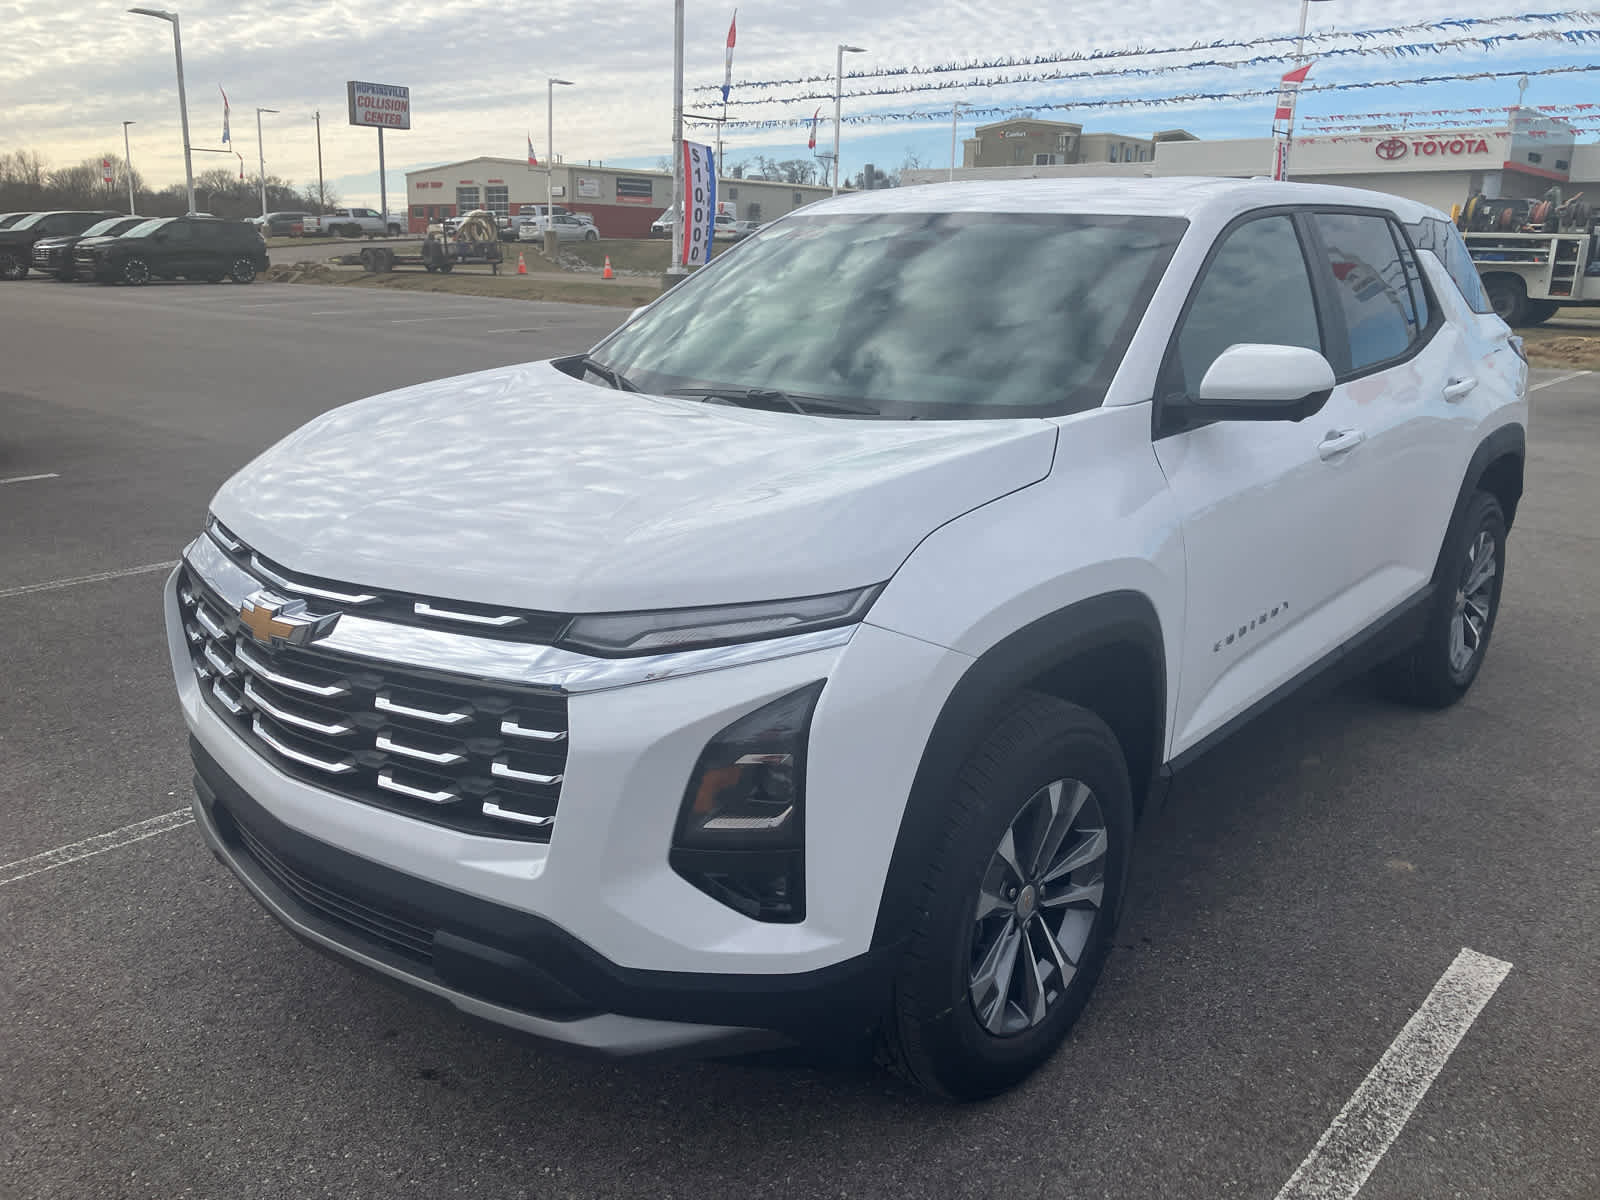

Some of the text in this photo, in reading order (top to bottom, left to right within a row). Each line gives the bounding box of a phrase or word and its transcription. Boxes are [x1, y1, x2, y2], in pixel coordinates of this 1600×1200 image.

[357, 95, 408, 113] COLLISION
[364, 110, 402, 125] CENTER
[1412, 139, 1489, 156] TOYOTA
